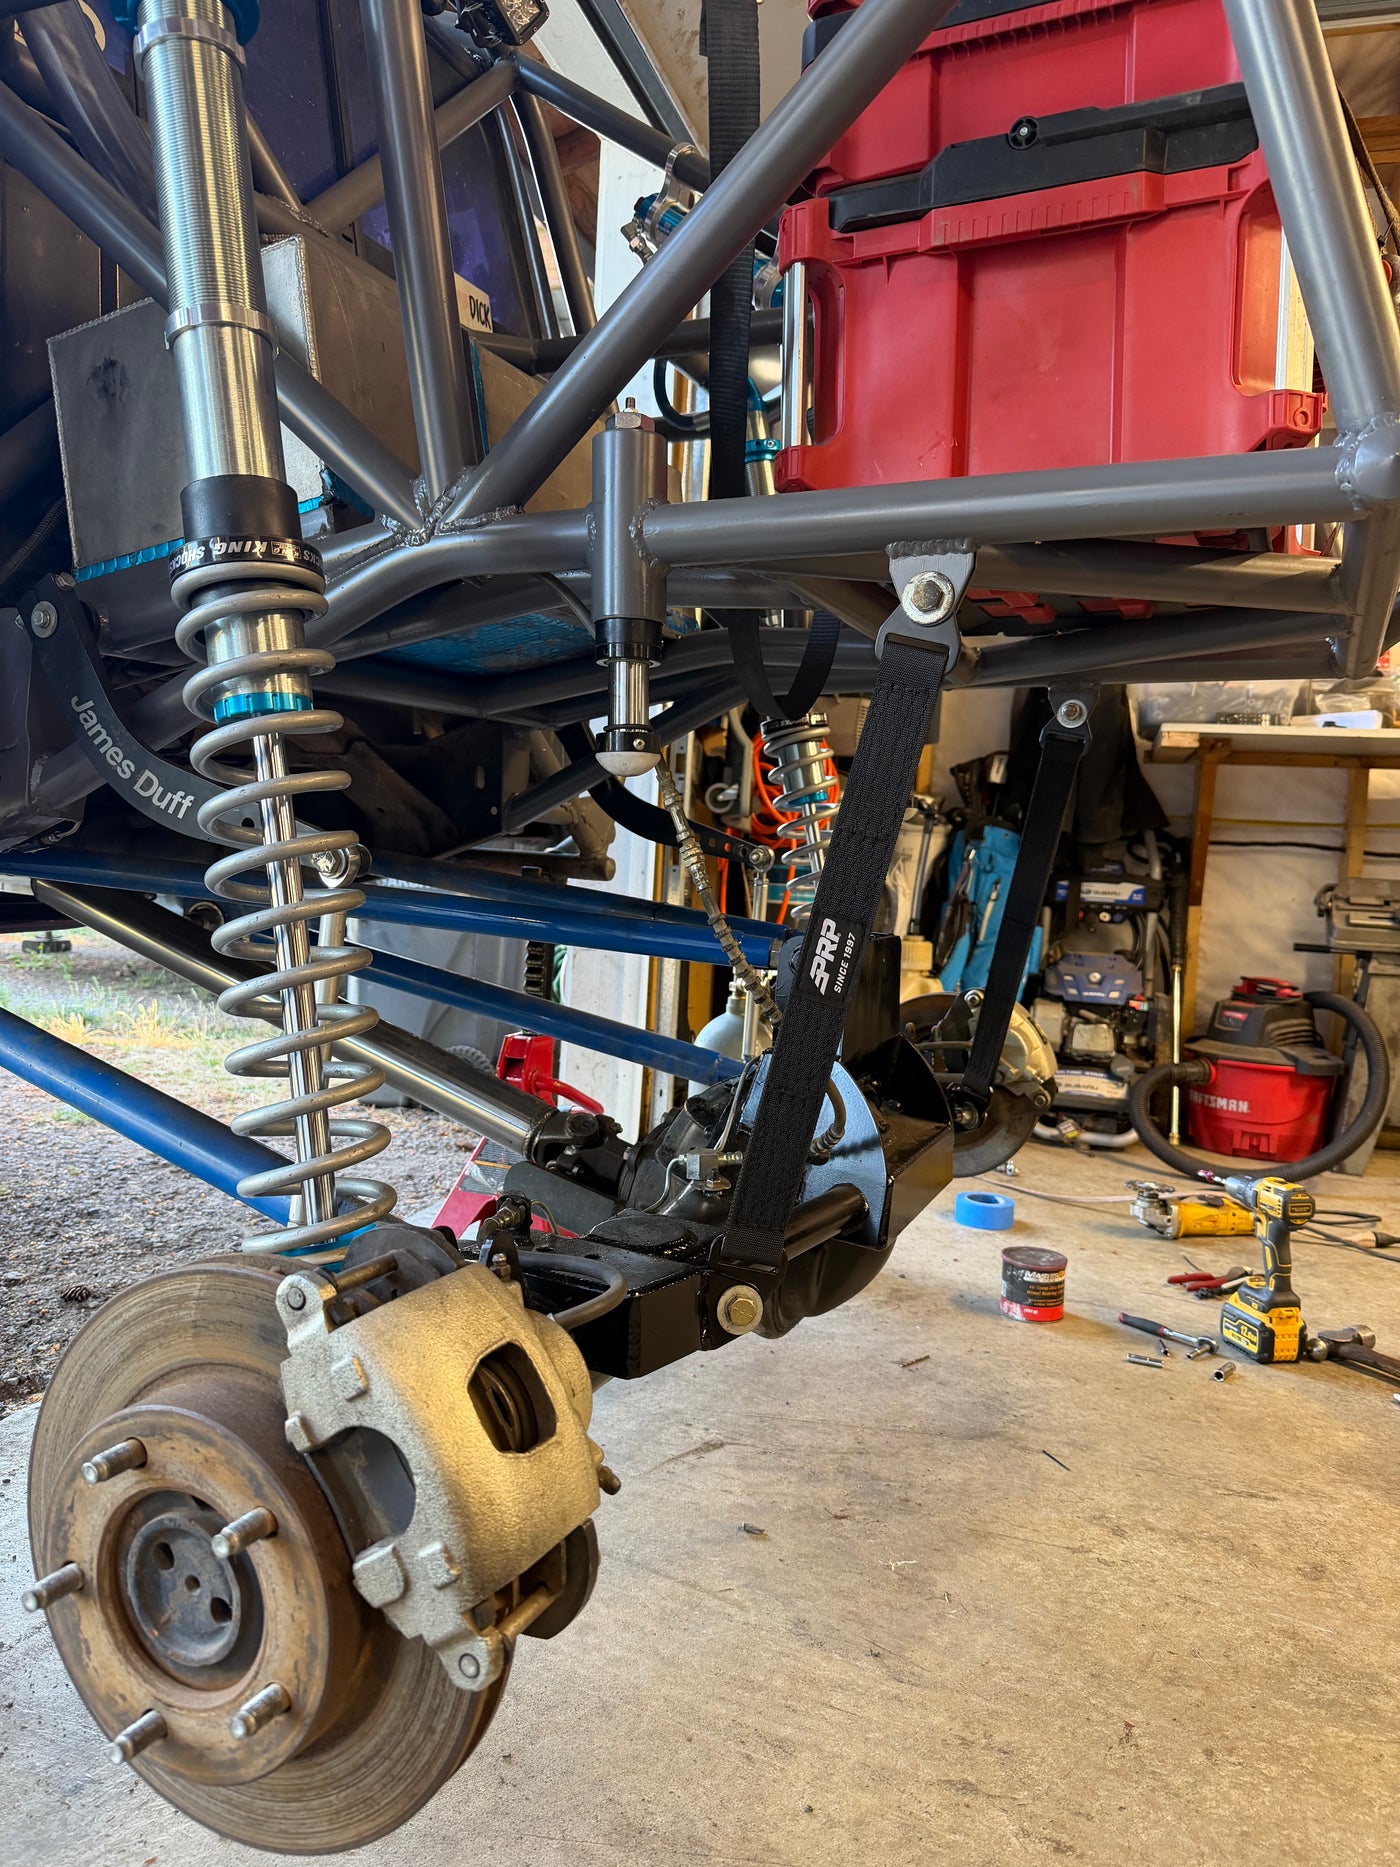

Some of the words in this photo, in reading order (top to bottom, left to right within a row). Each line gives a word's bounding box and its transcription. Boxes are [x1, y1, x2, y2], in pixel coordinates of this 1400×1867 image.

[468, 295, 492, 332] DICK
[212, 539, 268, 556] KING
[70, 695, 136, 780] James
[133, 769, 195, 820] Duff
[809, 917, 841, 996] PRP
[833, 959, 849, 994] SINCE
[843, 932, 856, 960] 1997
